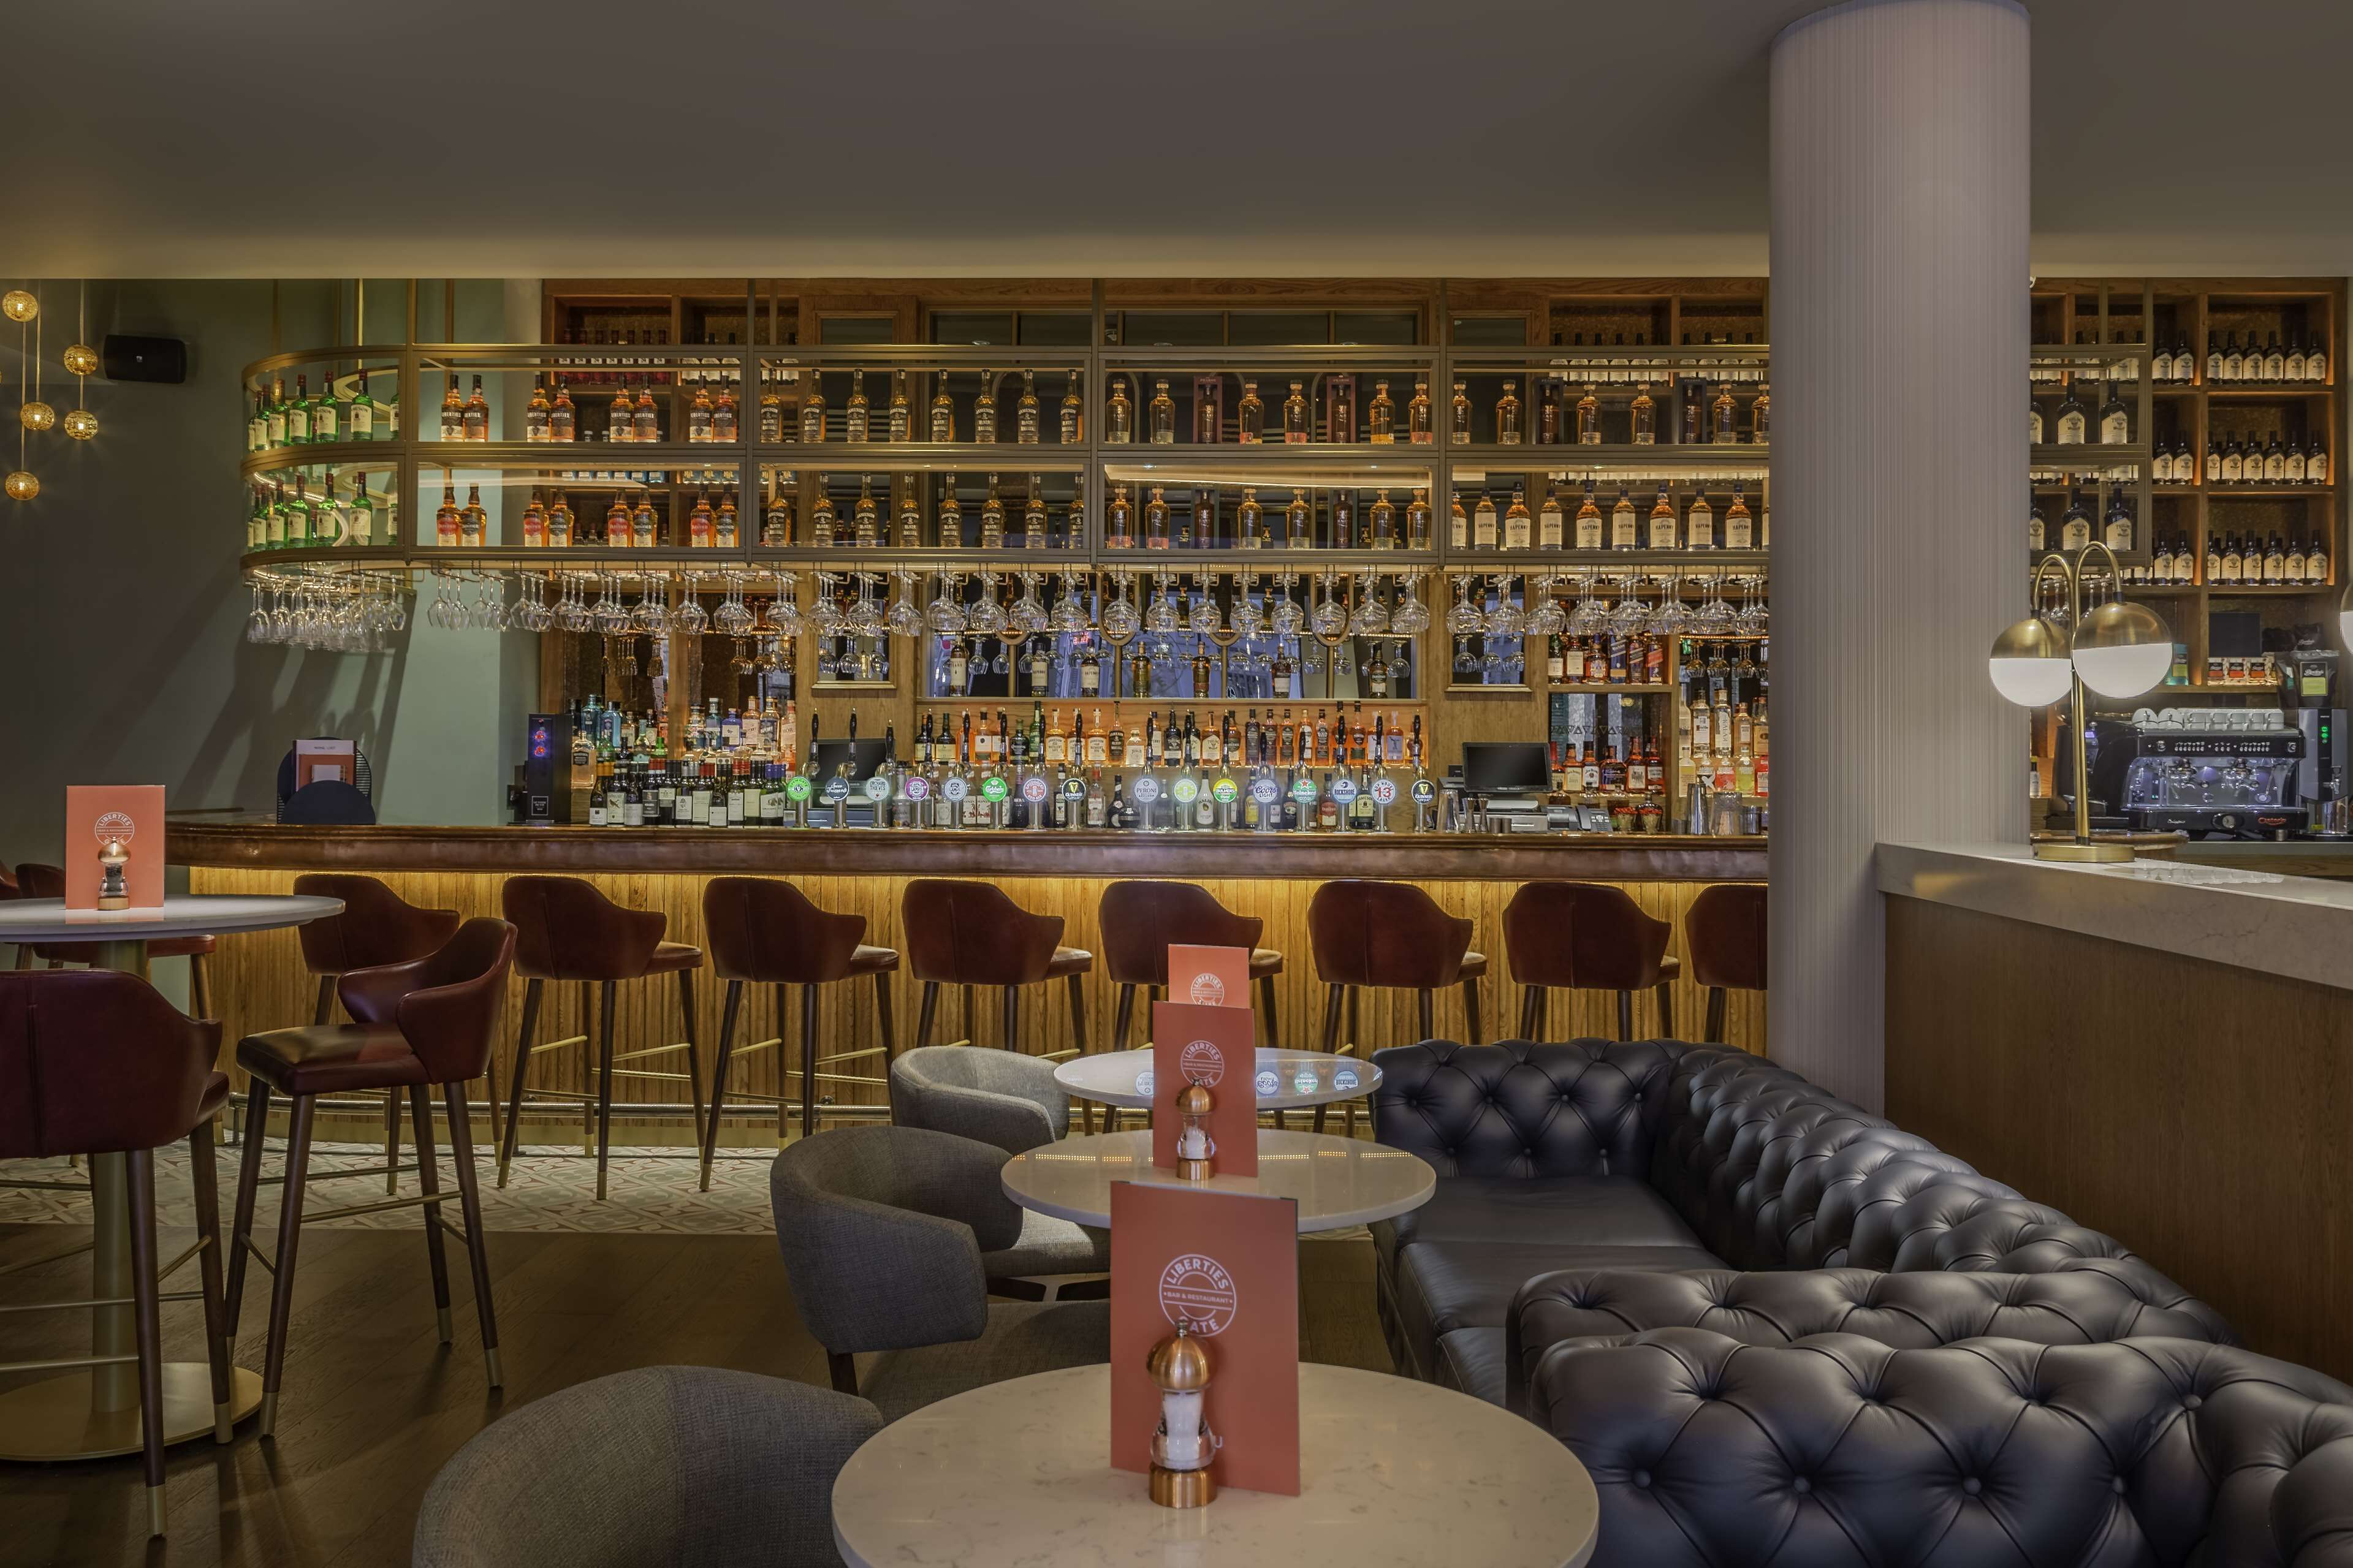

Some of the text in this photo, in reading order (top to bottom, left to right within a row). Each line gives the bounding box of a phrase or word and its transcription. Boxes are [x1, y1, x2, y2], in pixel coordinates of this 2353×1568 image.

[985, 786, 1004, 794] Carlsberg
[1255, 786, 1277, 794] Coors
[1377, 787, 1391, 798] 13
[99, 814, 131, 826] LIBERTIES
[1194, 975, 1221, 989] LIBERTIES
[1185, 1042, 1220, 1061] LIBERTIES
[1166, 1258, 1230, 1289] LIBERTIES
[1187, 1293, 1228, 1304] RESTAURANT
